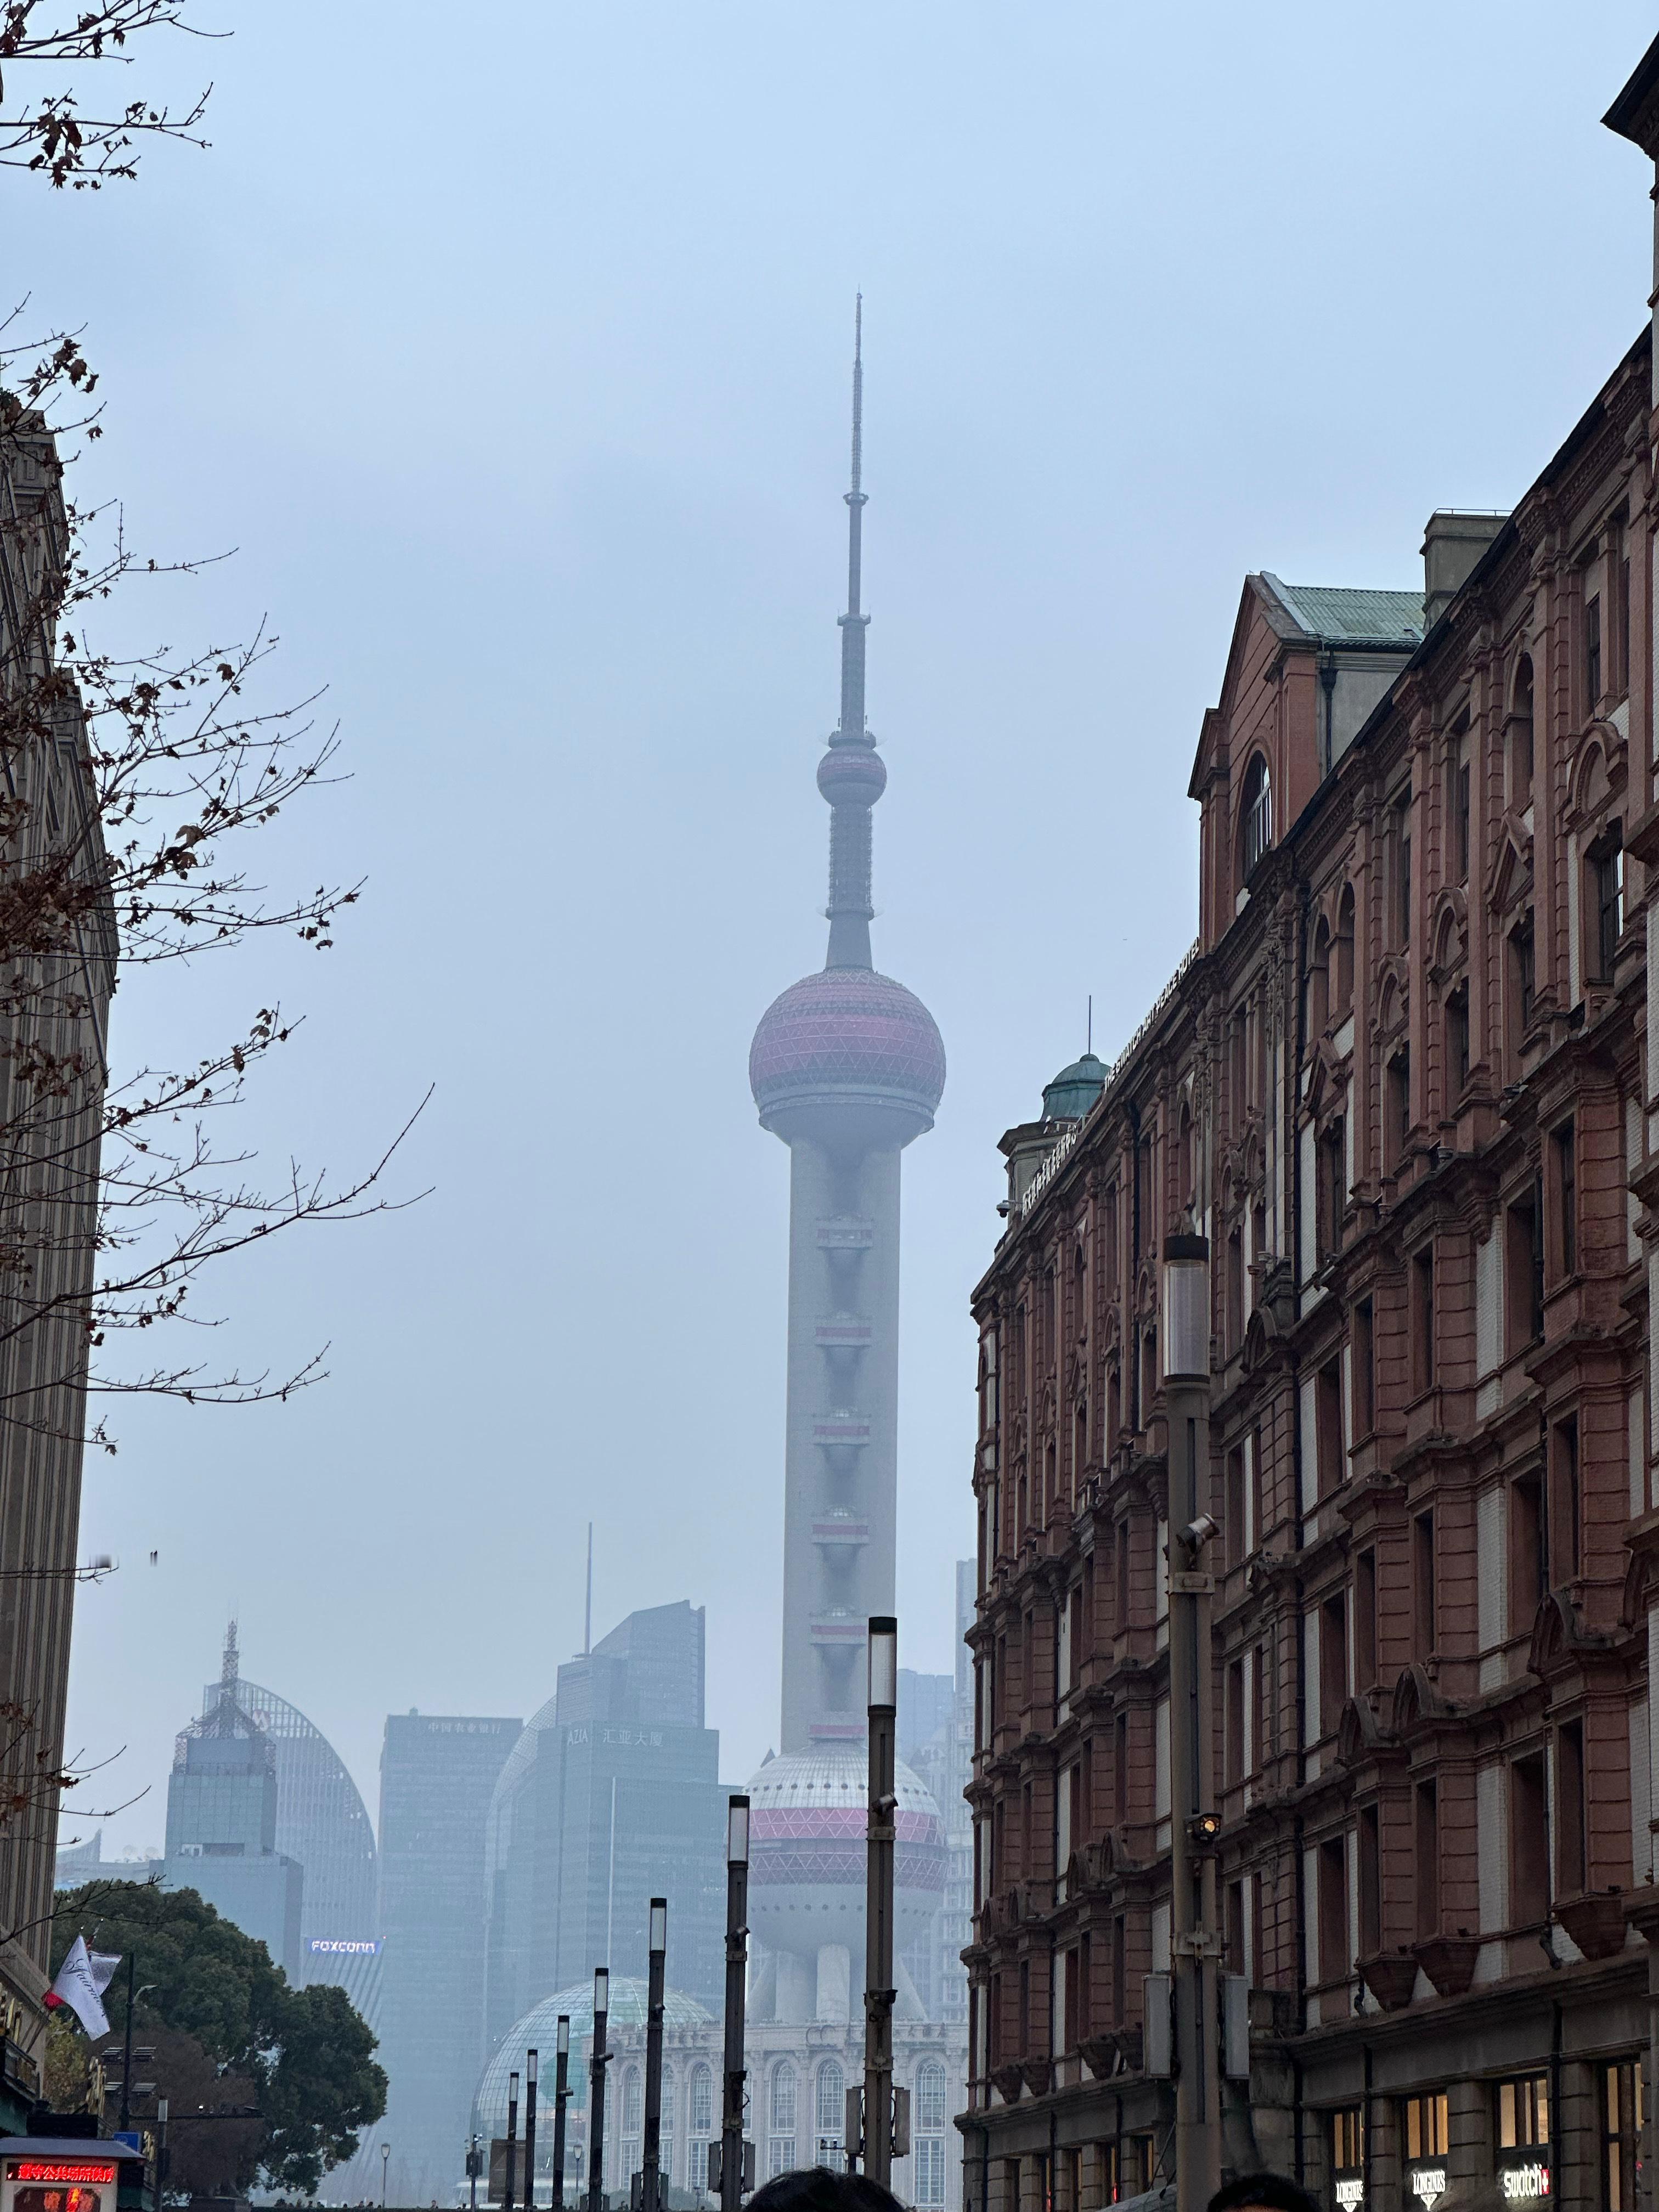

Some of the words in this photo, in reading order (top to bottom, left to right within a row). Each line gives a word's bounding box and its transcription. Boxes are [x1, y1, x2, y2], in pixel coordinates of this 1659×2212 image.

[1104, 1063, 1116, 1092] THE
[1156, 969, 1178, 1014] PEACE
[1178, 936, 1199, 980] HOTEL
[567, 1729, 588, 1746] AZIA
[603, 1729, 663, 1747] 汇亚大厦
[1335, 2180, 1364, 2203] LONGINES
[1413, 2169, 1446, 2195] LONGINES
[1504, 2163, 1542, 2198] swatch
